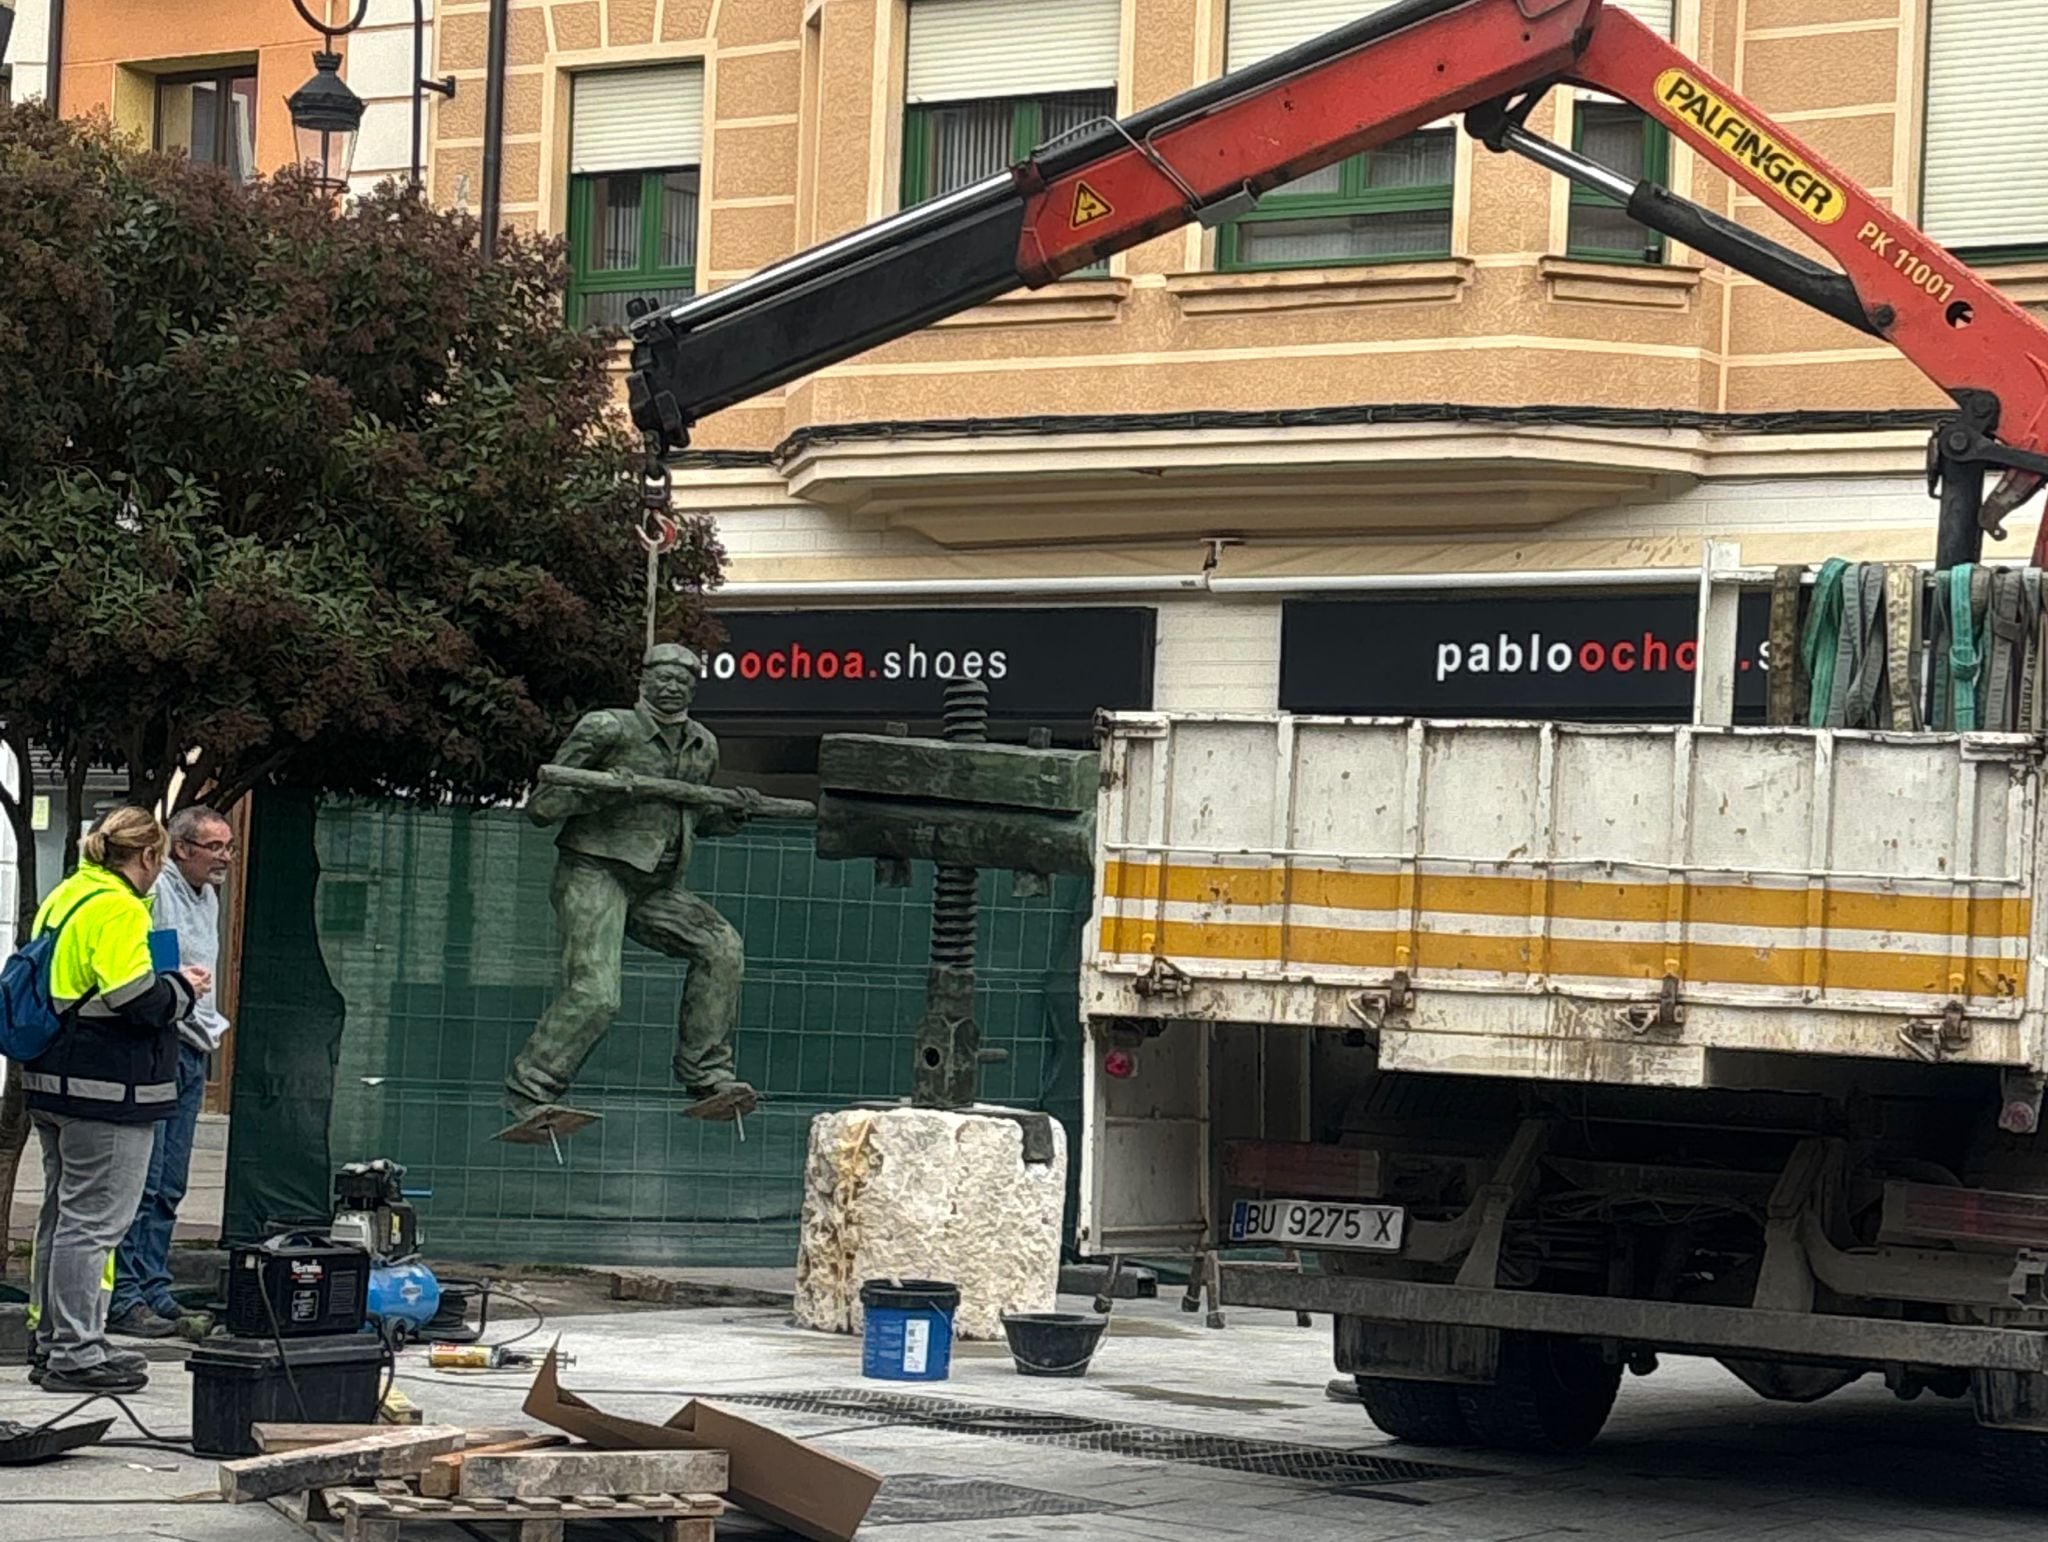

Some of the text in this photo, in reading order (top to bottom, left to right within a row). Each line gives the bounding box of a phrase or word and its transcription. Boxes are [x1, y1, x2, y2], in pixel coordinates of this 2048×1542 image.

[1664, 76, 1833, 215] PALFINGER
[1856, 220, 1955, 303] PK 11001
[1246, 1204, 1277, 1234] BU
[1287, 1206, 1361, 1240] 9275
[1373, 1211, 1394, 1242] X
